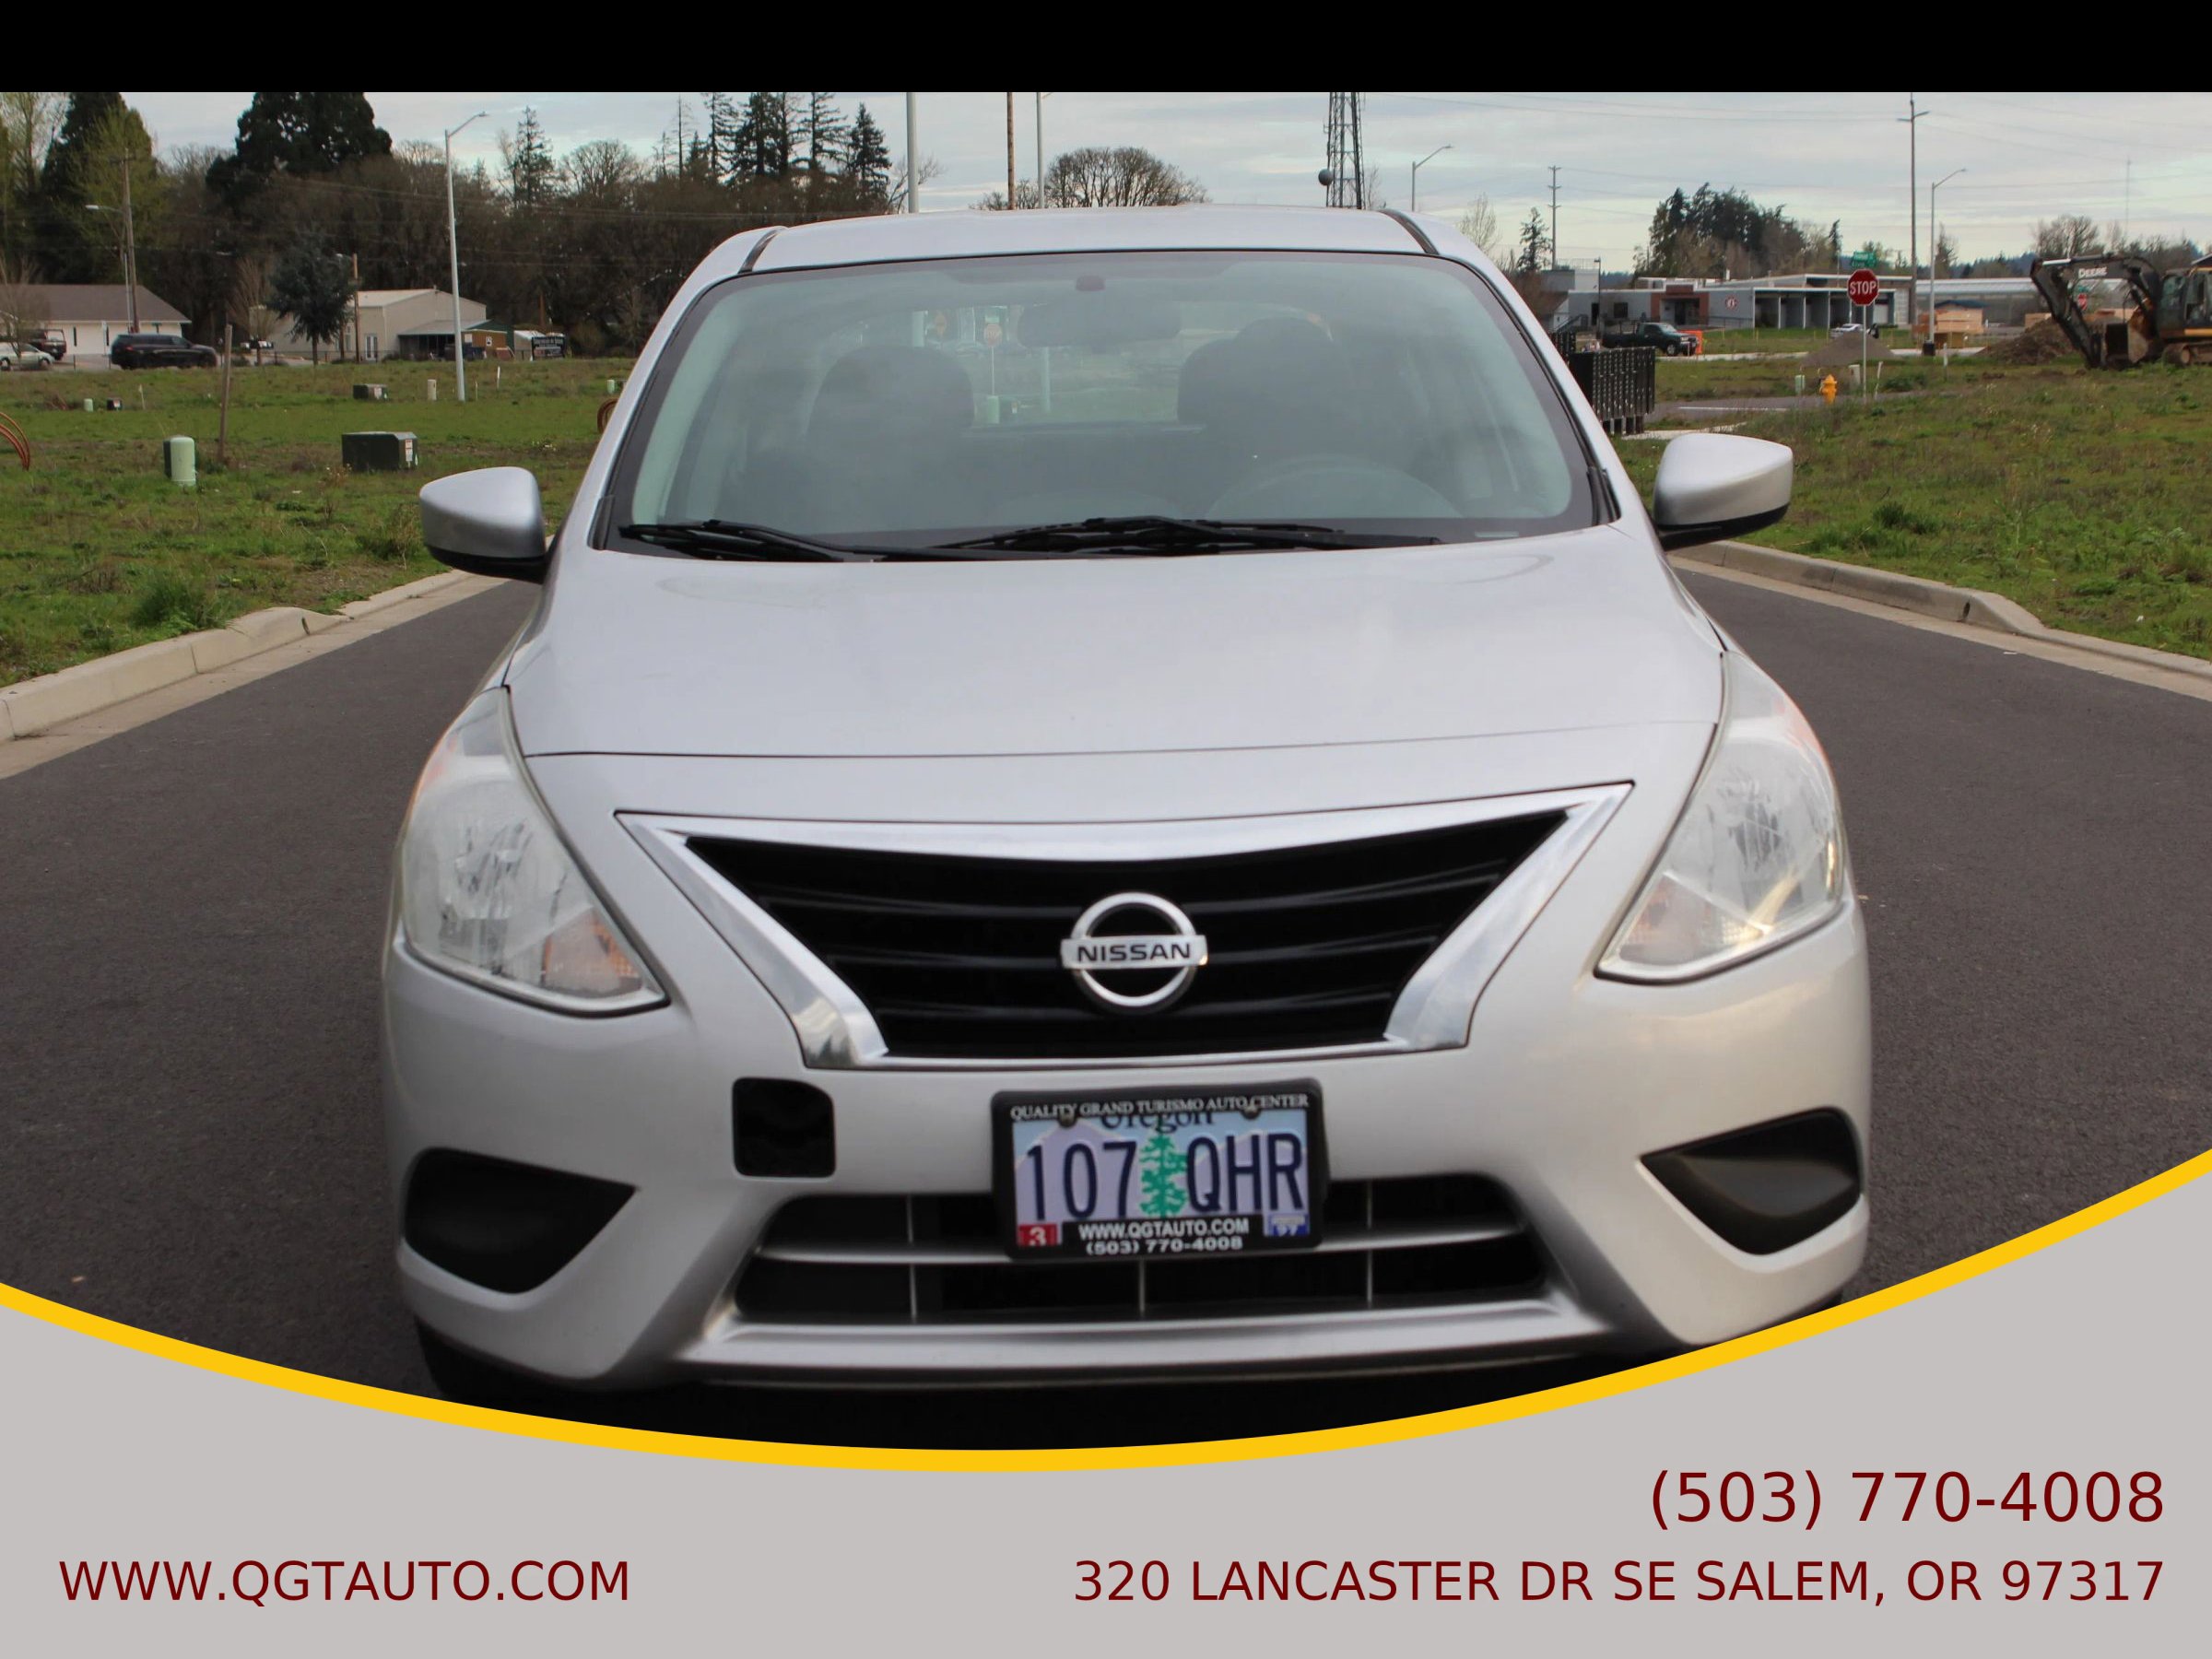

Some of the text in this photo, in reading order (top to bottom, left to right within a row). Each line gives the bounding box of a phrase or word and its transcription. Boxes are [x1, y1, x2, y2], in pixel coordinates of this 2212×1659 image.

[2078, 266, 2108, 278] DEERE
[1849, 280, 1877, 295] STOP
[1077, 943, 1191, 961] NISSAN
[1010, 1094, 1310, 1120] QUALITY GRAND TURISMO AUTO CENTER
[1027, 1132, 1304, 1221] 107 QHR
[1030, 1226, 1046, 1246] 3
[1078, 1218, 1250, 1240] WWW.QGTAUTO.COM
[1086, 1236, 1244, 1255] (503) 770-4008
